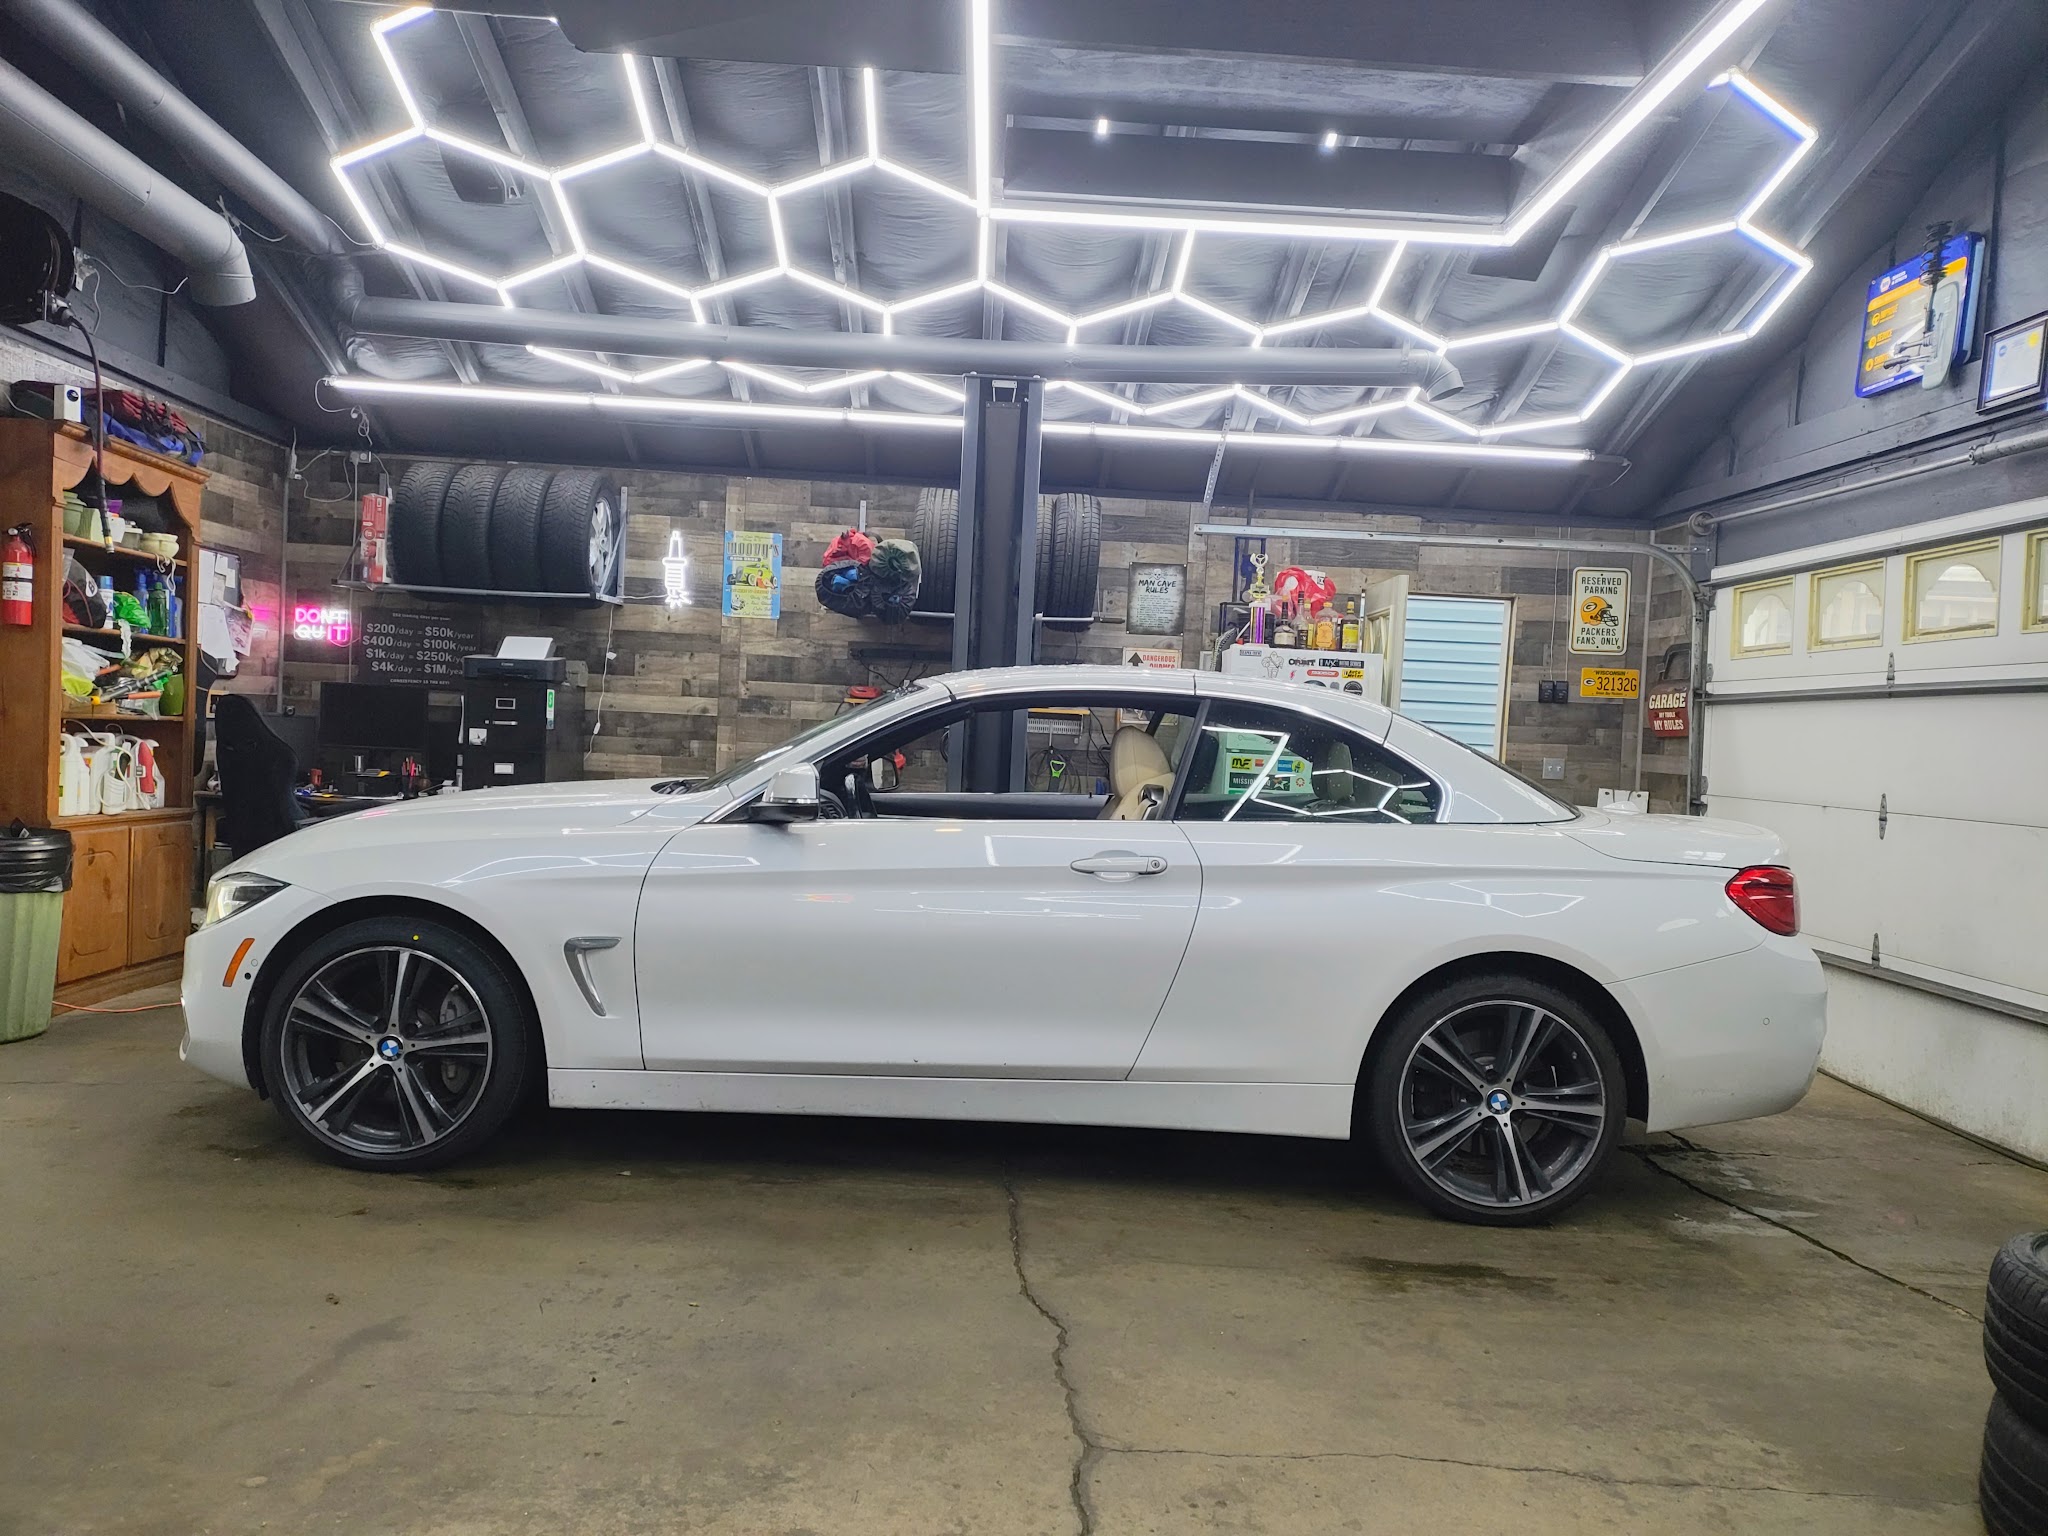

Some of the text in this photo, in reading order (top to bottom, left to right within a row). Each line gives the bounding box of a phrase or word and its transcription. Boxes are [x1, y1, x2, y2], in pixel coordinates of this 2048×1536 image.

[1138, 579, 1177, 588] MAN CAVE
[1581, 576, 1622, 586] RESERVED
[1145, 586, 1169, 594] RULES
[1584, 585, 1618, 595] PARKING
[366, 623, 414, 637] $200/day
[425, 626, 474, 640] $50k/year
[1580, 627, 1617, 637] PACKERS
[362, 635, 412, 649] $400/day
[423, 639, 477, 652] $100k/year
[1576, 636, 1619, 646] FANS ONLY
[366, 648, 405, 662] $1k/day
[1142, 654, 1176, 663] DANGEROUS
[371, 661, 413, 674] $4k/day
[424, 664, 463, 676] $1M/yea
[1596, 676, 1637, 692] 32132G
[1648, 692, 1687, 709] GARAGE
[1653, 719, 1684, 731] MY RULES
[1232, 777, 1260, 786] MISSIO
